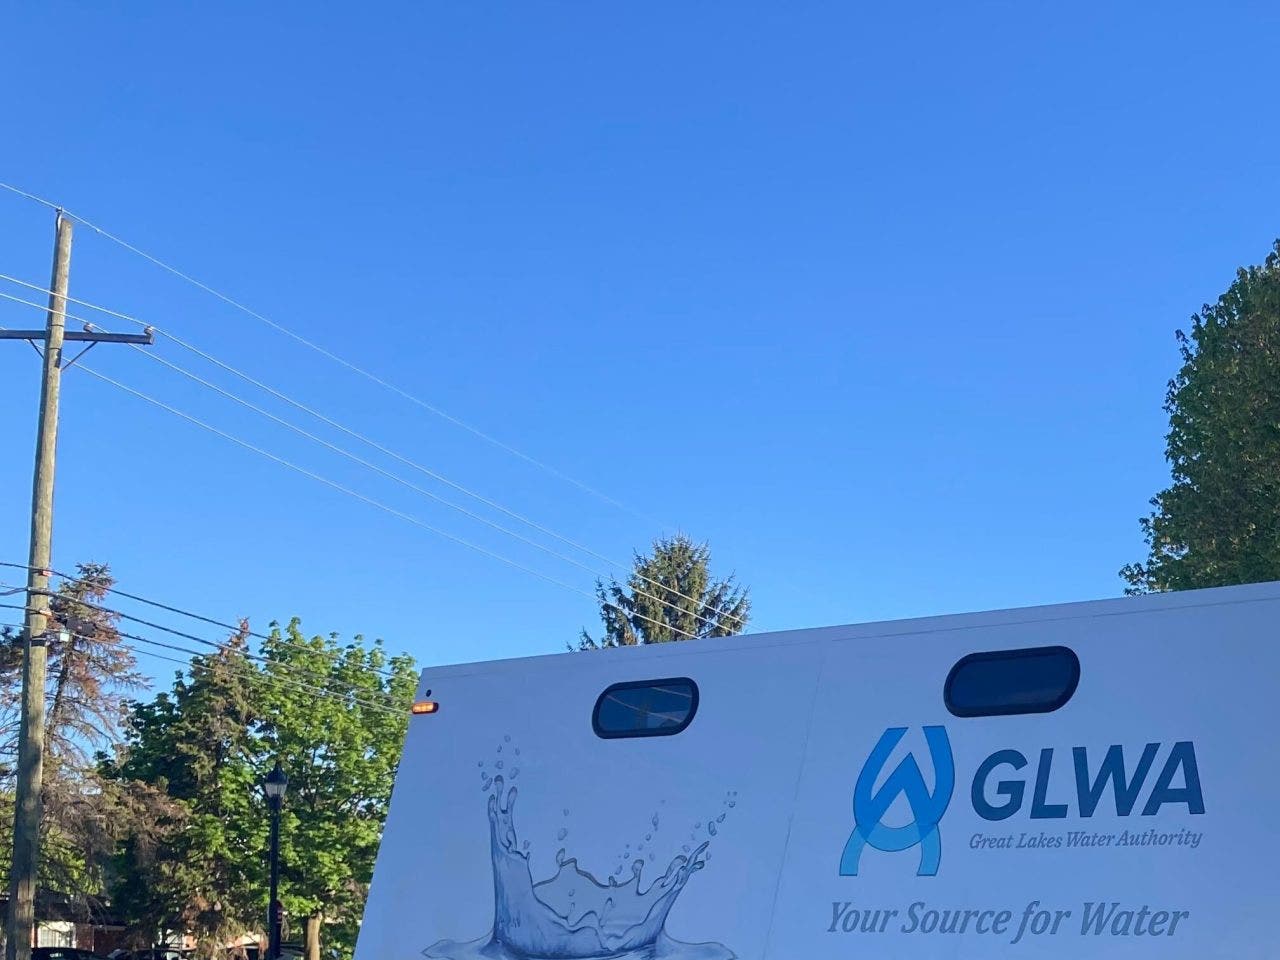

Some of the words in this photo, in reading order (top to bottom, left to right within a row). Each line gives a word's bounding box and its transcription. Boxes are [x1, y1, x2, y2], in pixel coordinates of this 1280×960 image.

[971, 741, 1205, 822] GLWA
[969, 832, 1013, 850] Great
[1016, 831, 1063, 849] Lakes
[1066, 830, 1115, 848] Water
[1116, 828, 1204, 850] Authority
[826, 901, 898, 934] Your
[901, 901, 1009, 935] Source
[1010, 900, 1072, 945] for
[1080, 902, 1189, 937] Water
